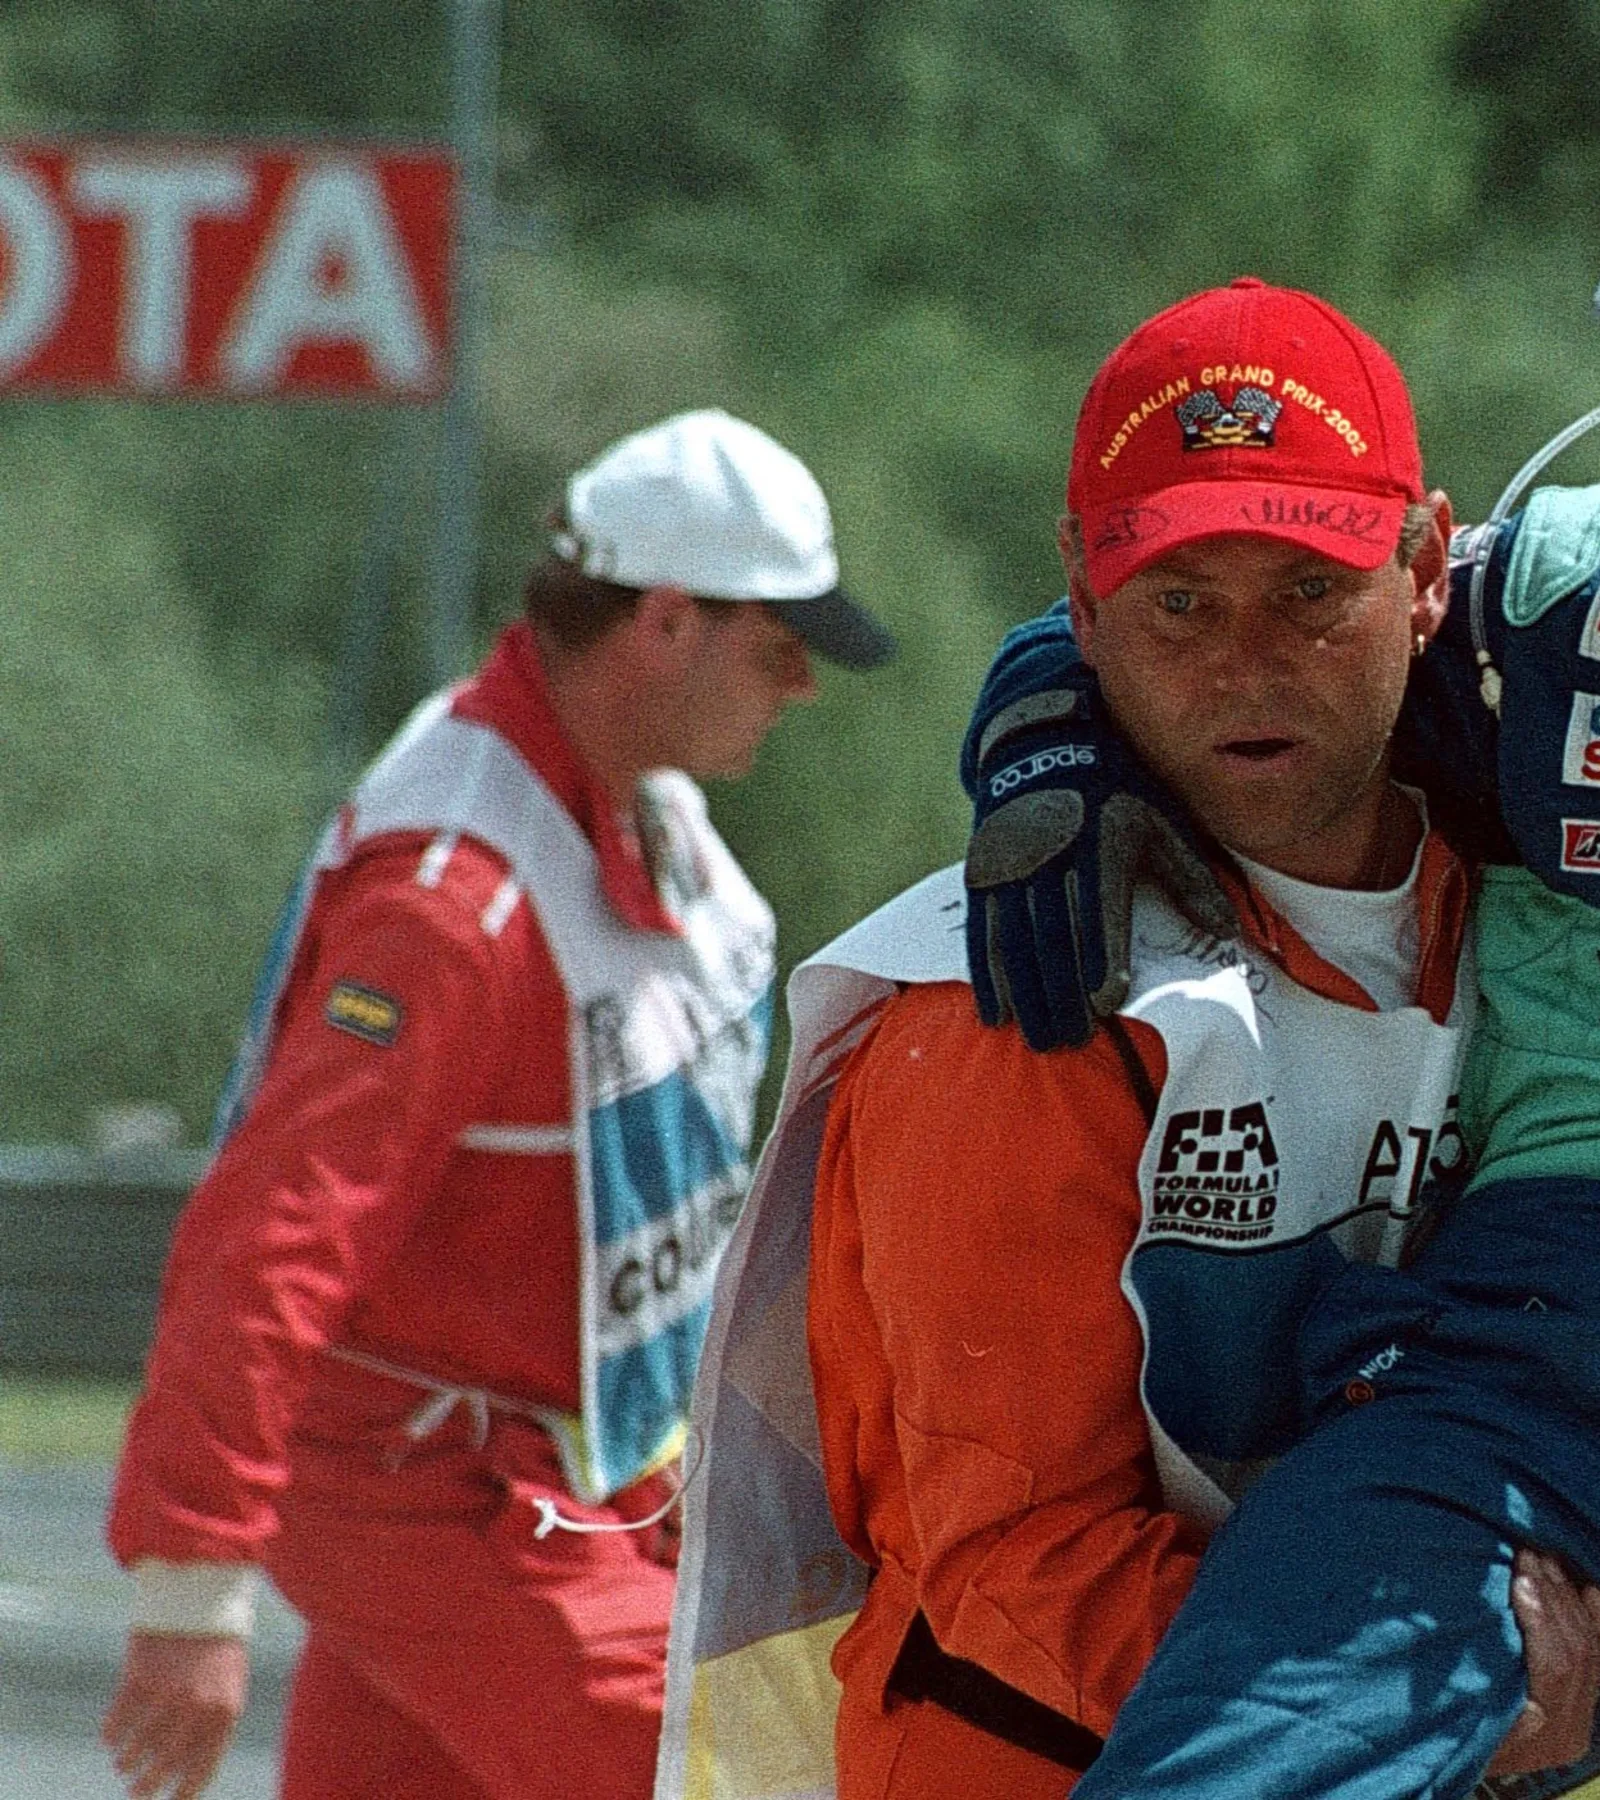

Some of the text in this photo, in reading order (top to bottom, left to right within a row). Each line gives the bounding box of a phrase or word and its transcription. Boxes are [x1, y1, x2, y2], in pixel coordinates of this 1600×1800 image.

[1099, 364, 1368, 470] AUSTRALIAN GRAND PRIX-2002
[989, 744, 1096, 797] sparco
[1153, 1174, 1270, 1194] FORMULA
[1153, 1194, 1278, 1223] WORLD
[1147, 1221, 1275, 1242] CHAMPIONSHIP
[1358, 1342, 1405, 1380] NICK
